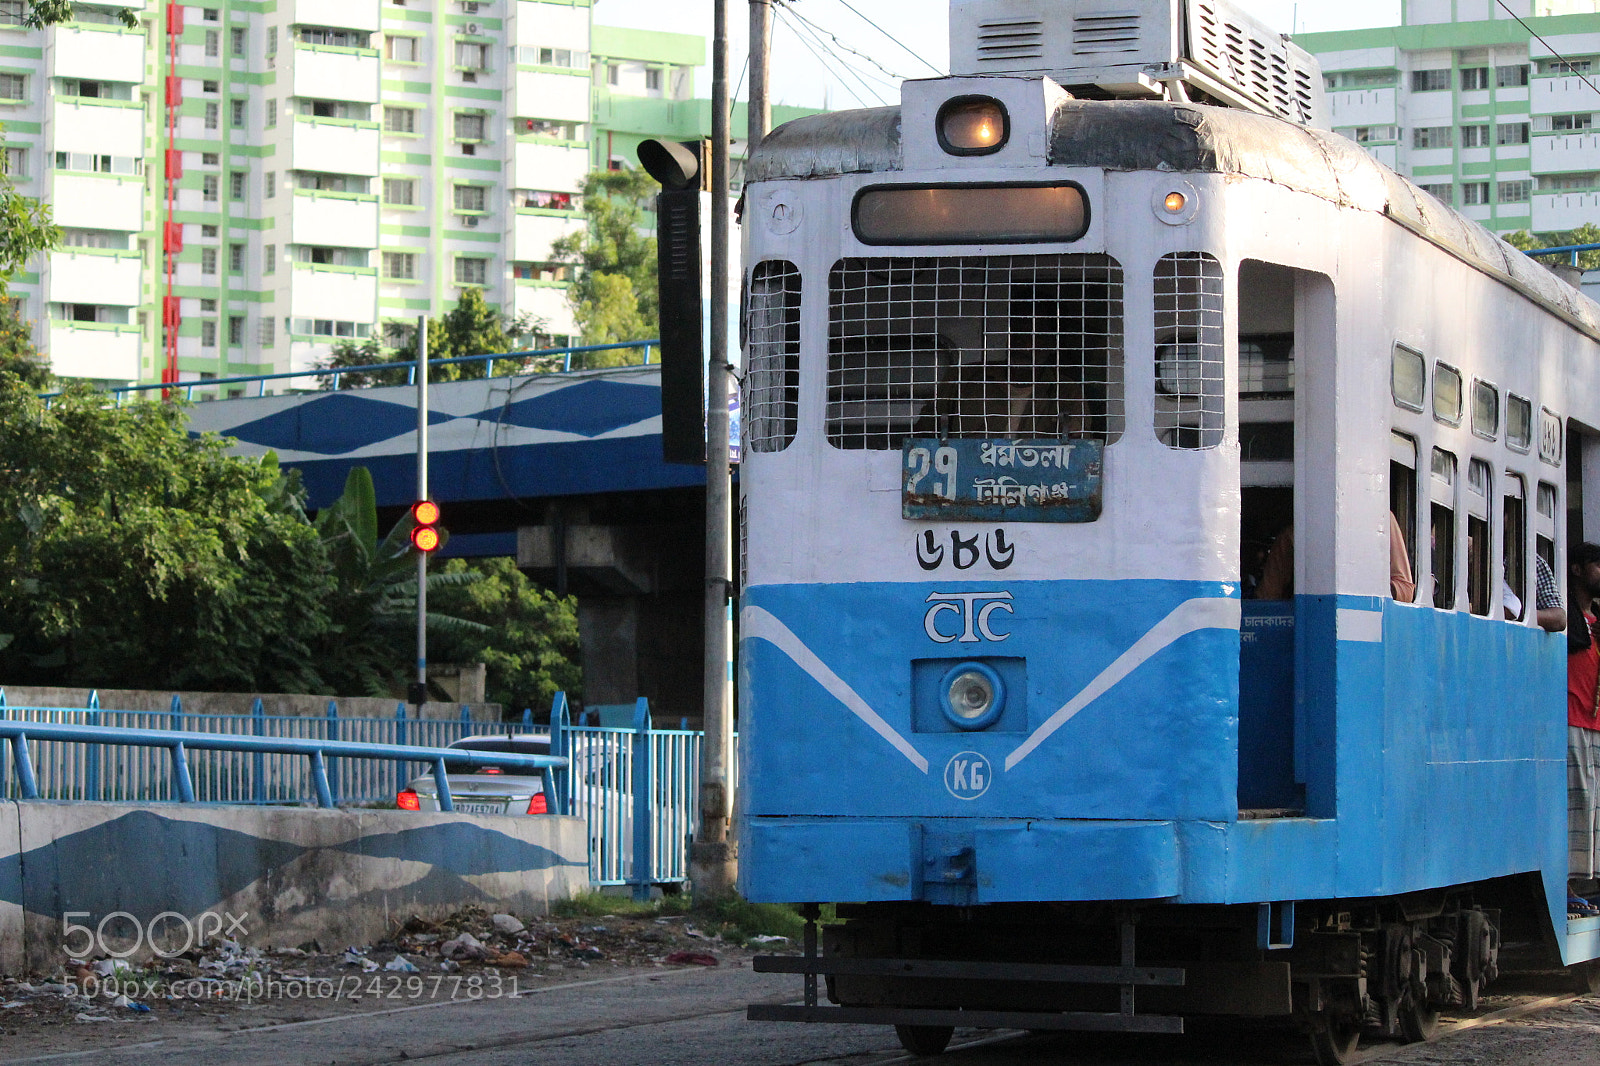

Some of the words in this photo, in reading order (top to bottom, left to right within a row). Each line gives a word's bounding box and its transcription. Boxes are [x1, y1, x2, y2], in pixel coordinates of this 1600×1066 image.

[906, 446, 958, 505] 29
[979, 439, 1076, 470] ধর্মতলা
[916, 529, 1015, 571] ৬৮৬
[923, 590, 1015, 643] CTC
[953, 759, 984, 791] KG
